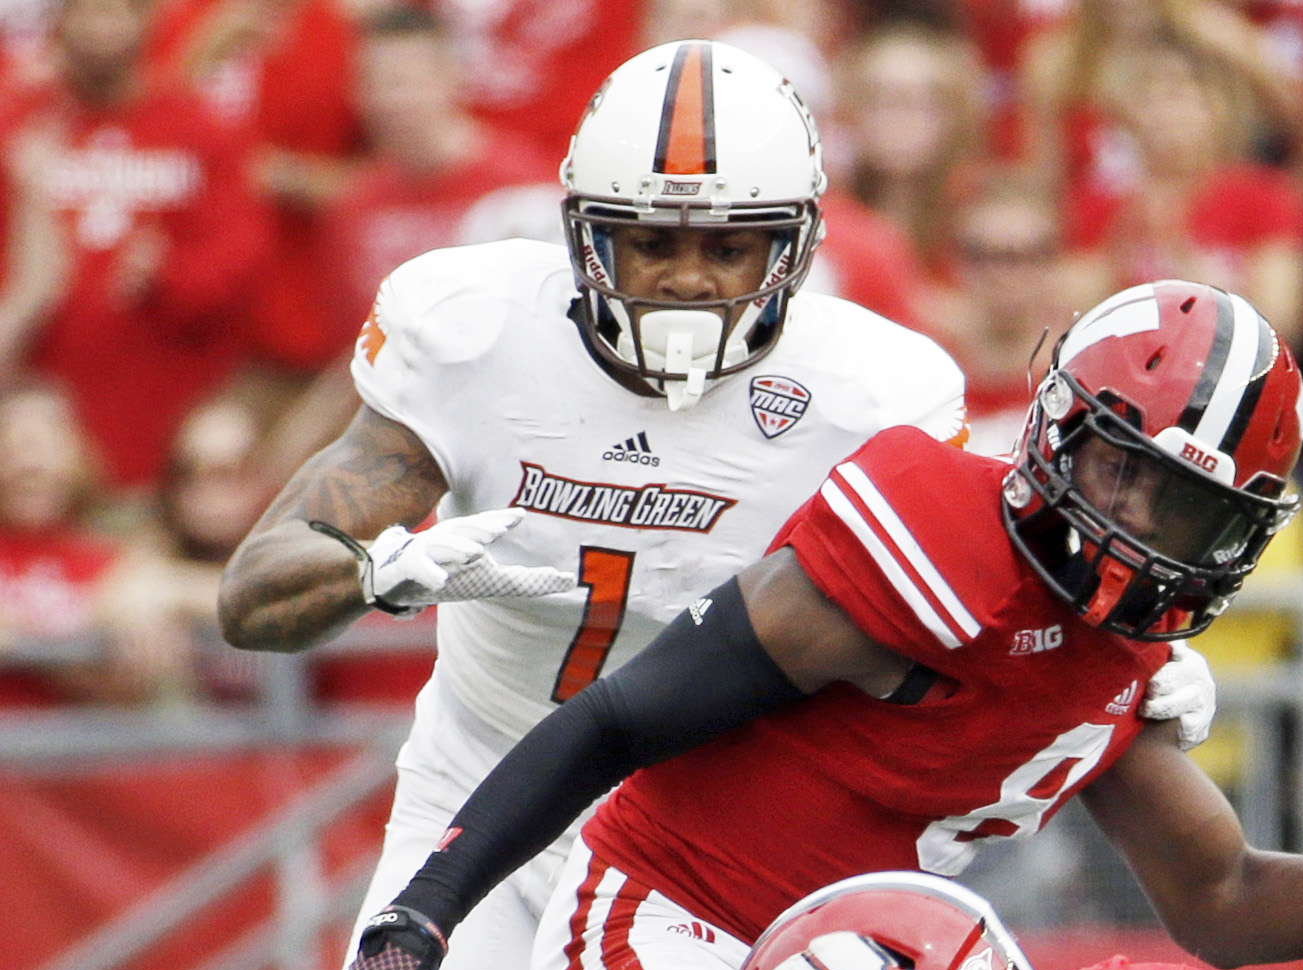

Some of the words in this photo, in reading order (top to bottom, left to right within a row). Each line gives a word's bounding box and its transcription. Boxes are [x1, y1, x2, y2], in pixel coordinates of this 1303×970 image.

[752, 390, 809, 419] MAC
[602, 450, 660, 467] adidas
[516, 466, 635, 523] BOWLING
[630, 487, 725, 530] GREEN
[550, 545, 636, 704] 1
[916, 722, 1115, 877] 8
